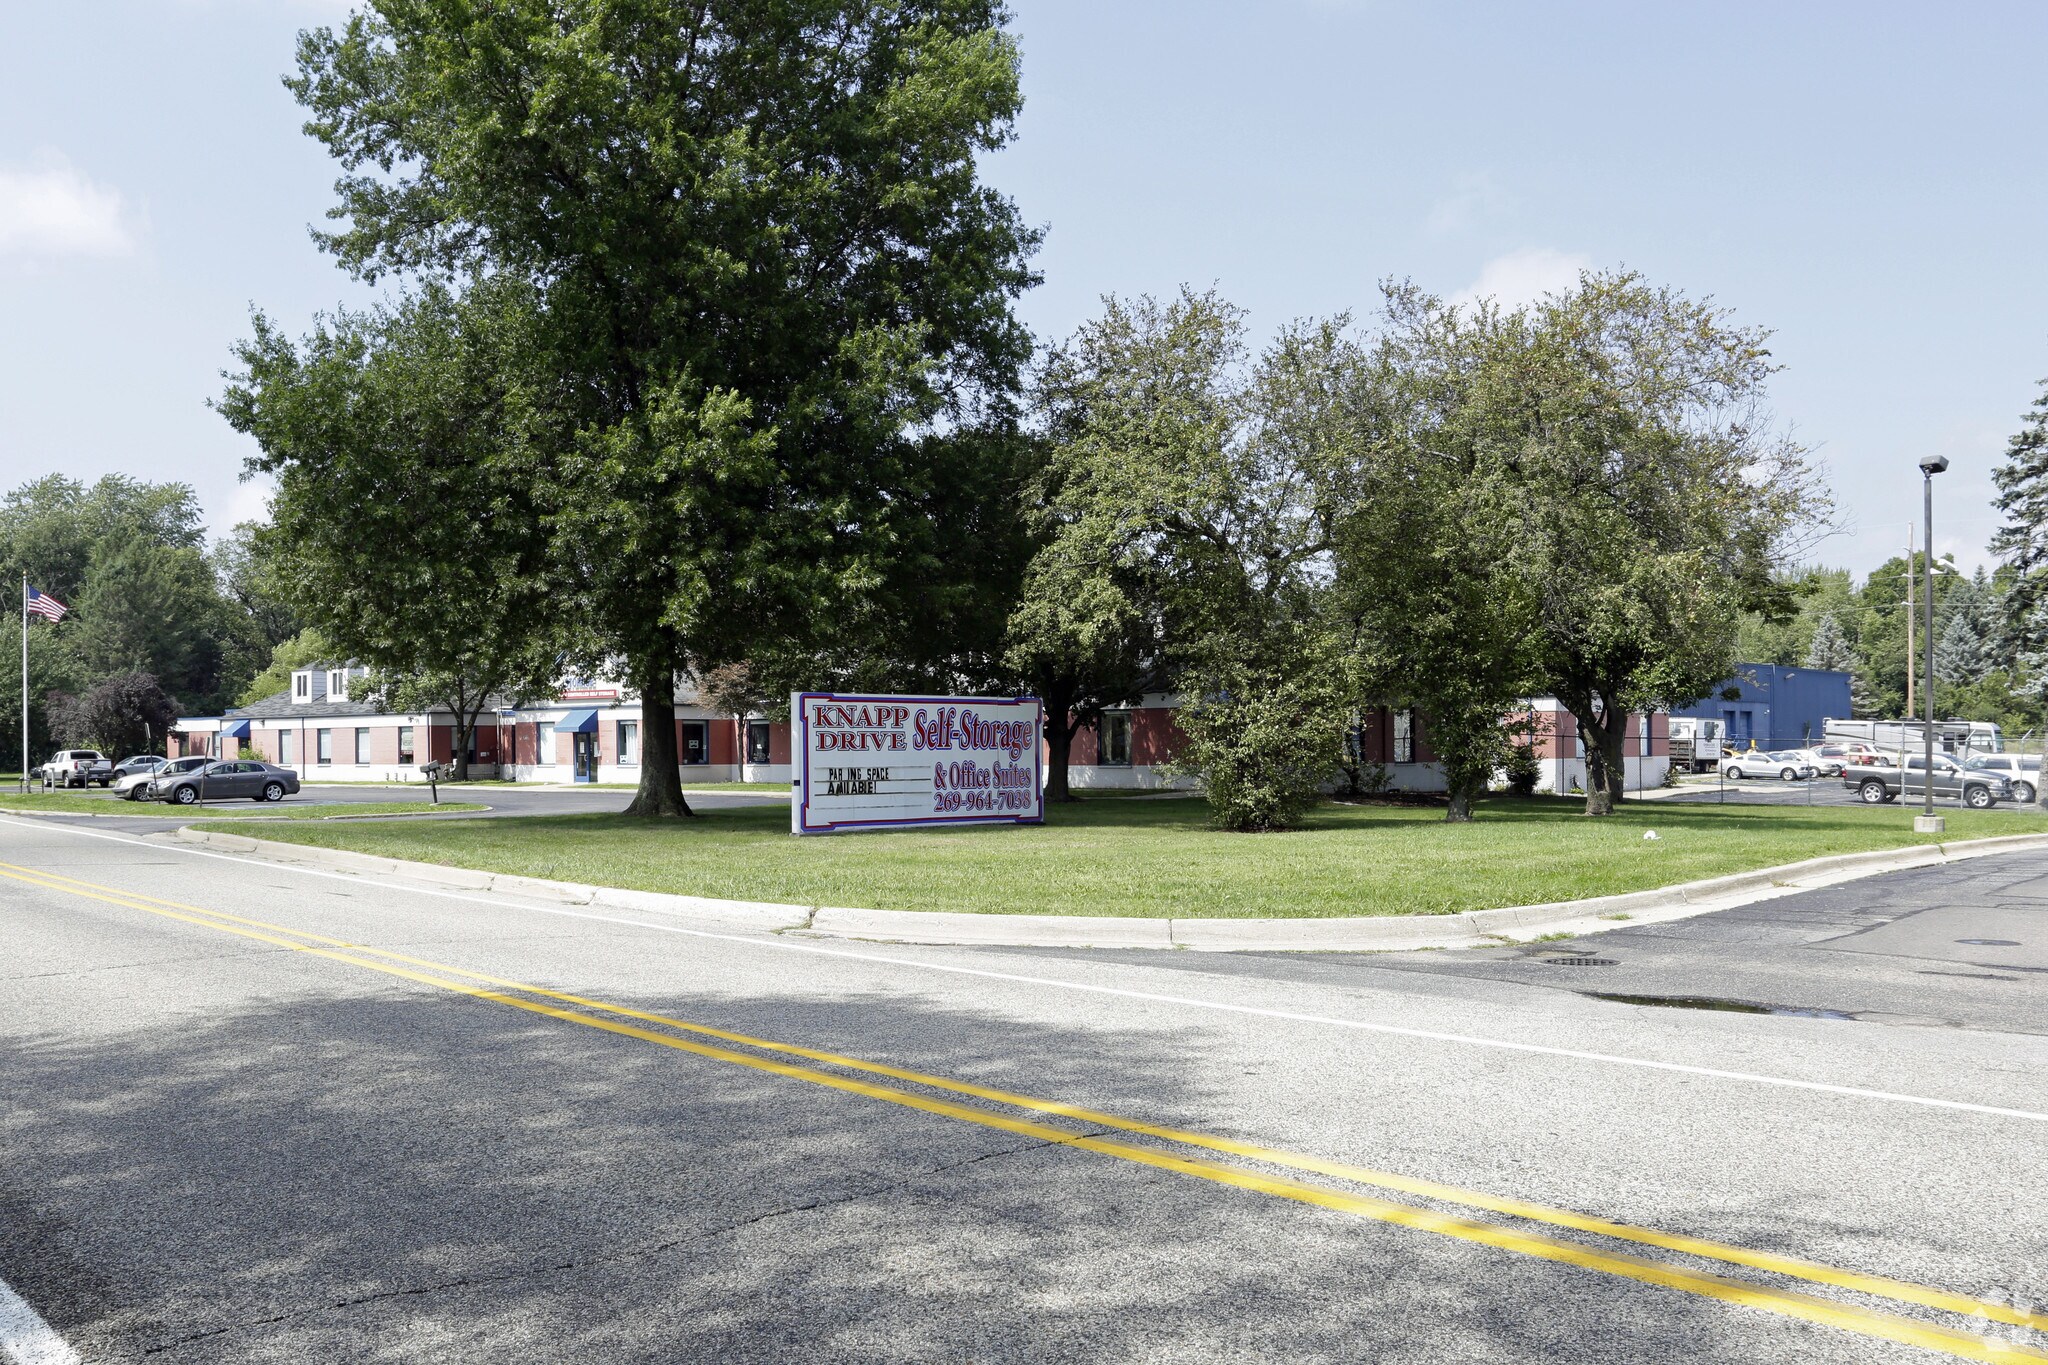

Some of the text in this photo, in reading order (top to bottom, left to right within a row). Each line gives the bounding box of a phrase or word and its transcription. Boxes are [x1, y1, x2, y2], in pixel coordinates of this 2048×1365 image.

[813, 704, 1033, 761] KNAPP Self-Storage
[815, 730, 907, 751] DRIVE
[867, 767, 889, 780] SPACE
[933, 760, 1032, 790] & Office Suites
[933, 789, 1031, 813] 269-964-7038
